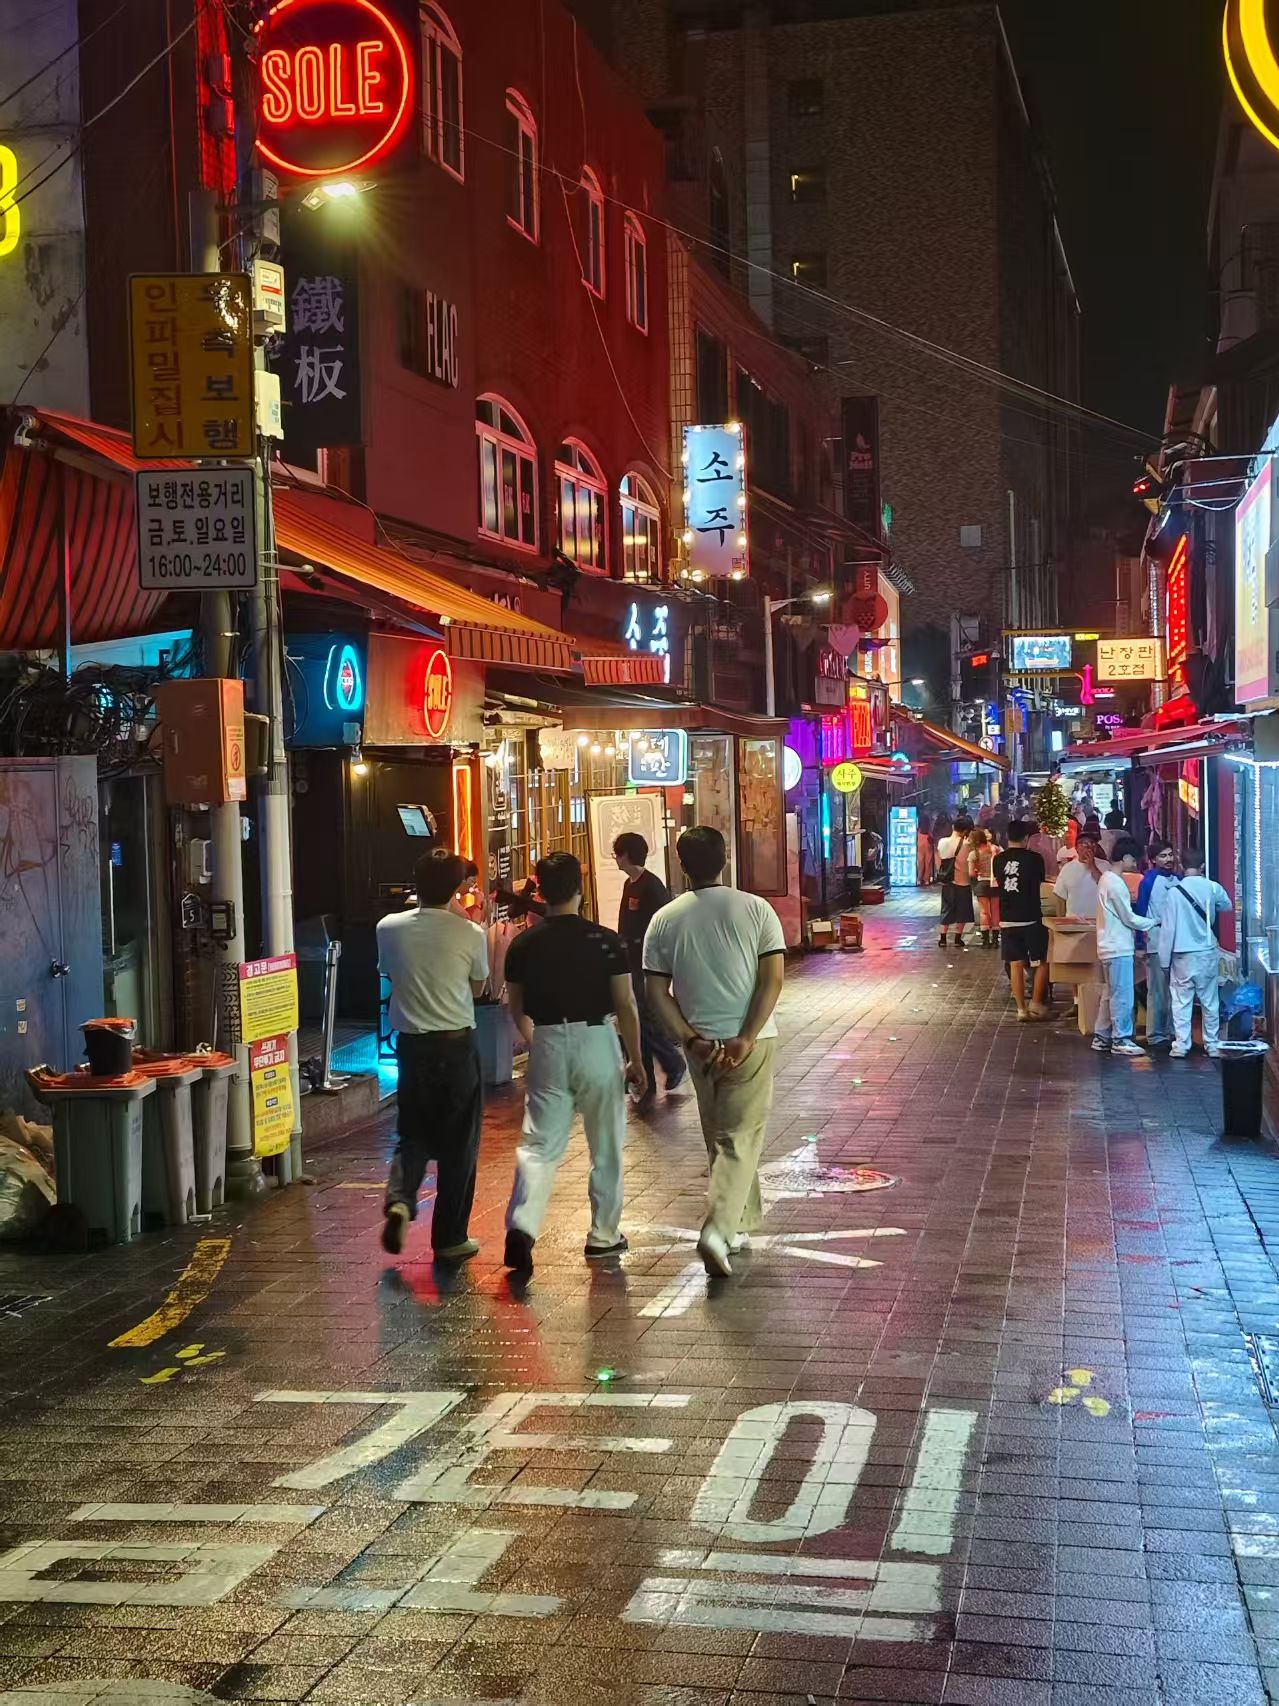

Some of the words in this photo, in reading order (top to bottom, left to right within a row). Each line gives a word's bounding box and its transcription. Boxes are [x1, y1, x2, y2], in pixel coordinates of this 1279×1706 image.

[262, 41, 384, 123] SOLE
[147, 480, 245, 510] 보행전용거리
[696, 451, 735, 547] 소주
[149, 553, 246, 577] 16:00~24:00
[1108, 664, 1145, 676] 2호점
[837, 768, 857, 780] 사주
